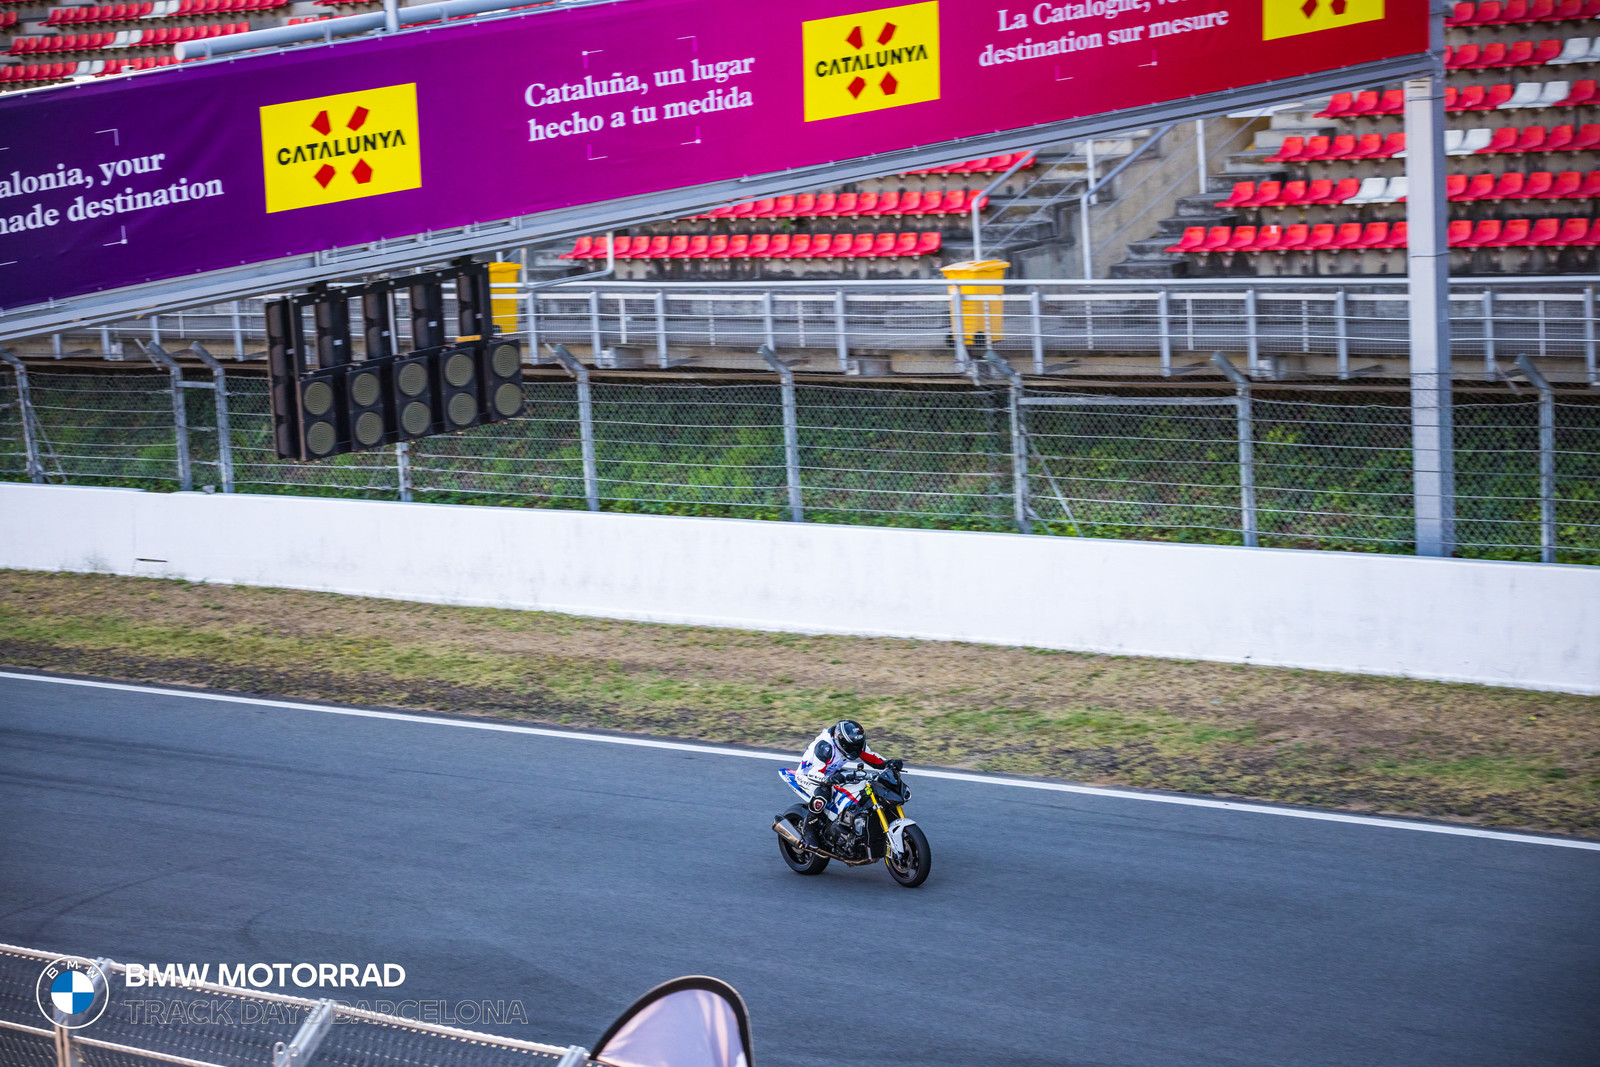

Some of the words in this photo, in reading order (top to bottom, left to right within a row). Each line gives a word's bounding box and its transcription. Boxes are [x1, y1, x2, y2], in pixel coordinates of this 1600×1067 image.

[997, 9, 1029, 32] La
[1033, 0, 1151, 25] Catalogne,
[978, 30, 1104, 67] destination
[1107, 25, 1145, 46] sur
[1148, 10, 1230, 38] mesure
[815, 44, 929, 78] CATALUNYA
[524, 70, 650, 108] Cataluña,
[653, 66, 687, 88] un
[691, 56, 756, 86] lugar
[528, 113, 604, 142] hecho
[609, 107, 627, 129] a
[631, 101, 659, 125] tu
[662, 85, 754, 118] medida
[277, 129, 407, 166] CATALUNYA
[98, 152, 166, 187] your
[66, 178, 225, 222] destination
